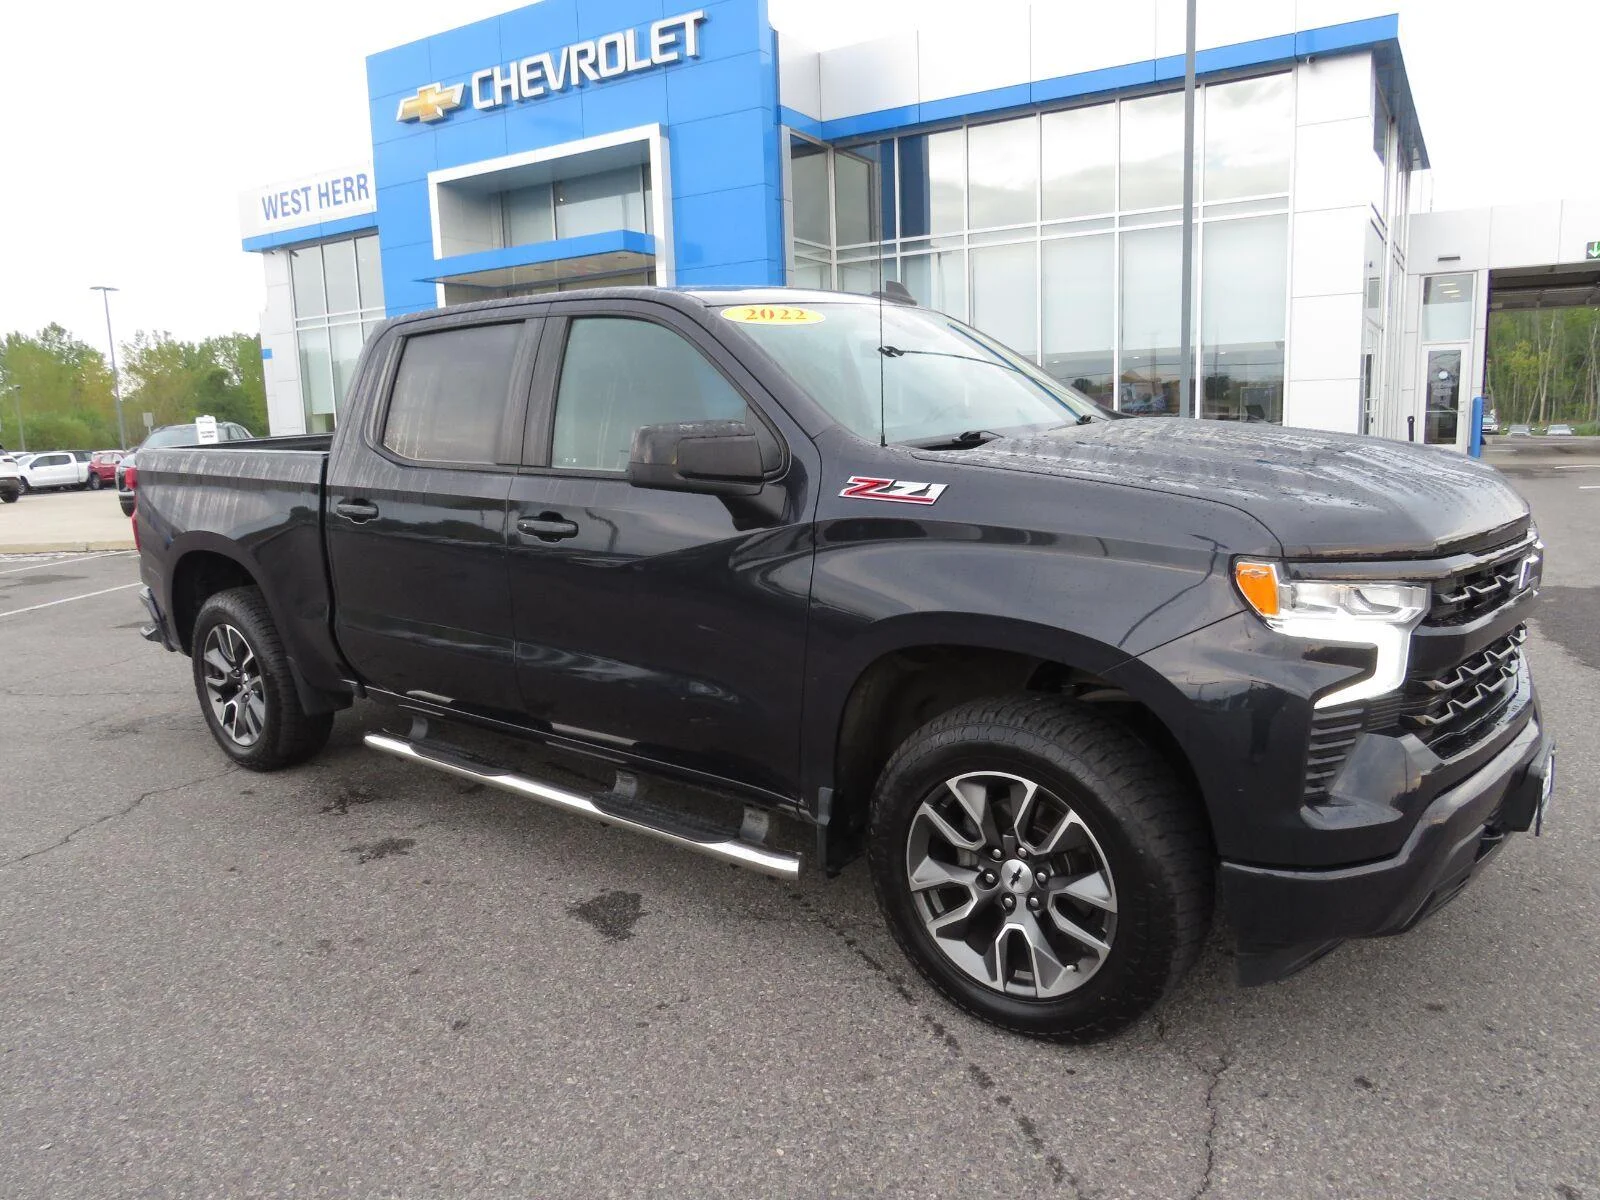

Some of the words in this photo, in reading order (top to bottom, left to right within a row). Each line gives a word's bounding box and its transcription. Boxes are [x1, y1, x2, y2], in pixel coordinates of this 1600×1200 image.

[471, 9, 705, 110] CHEVROLET
[262, 186, 312, 221] WEST
[317, 173, 370, 209] HERR
[745, 308, 807, 320] 2022
[838, 475, 949, 505] Z71
